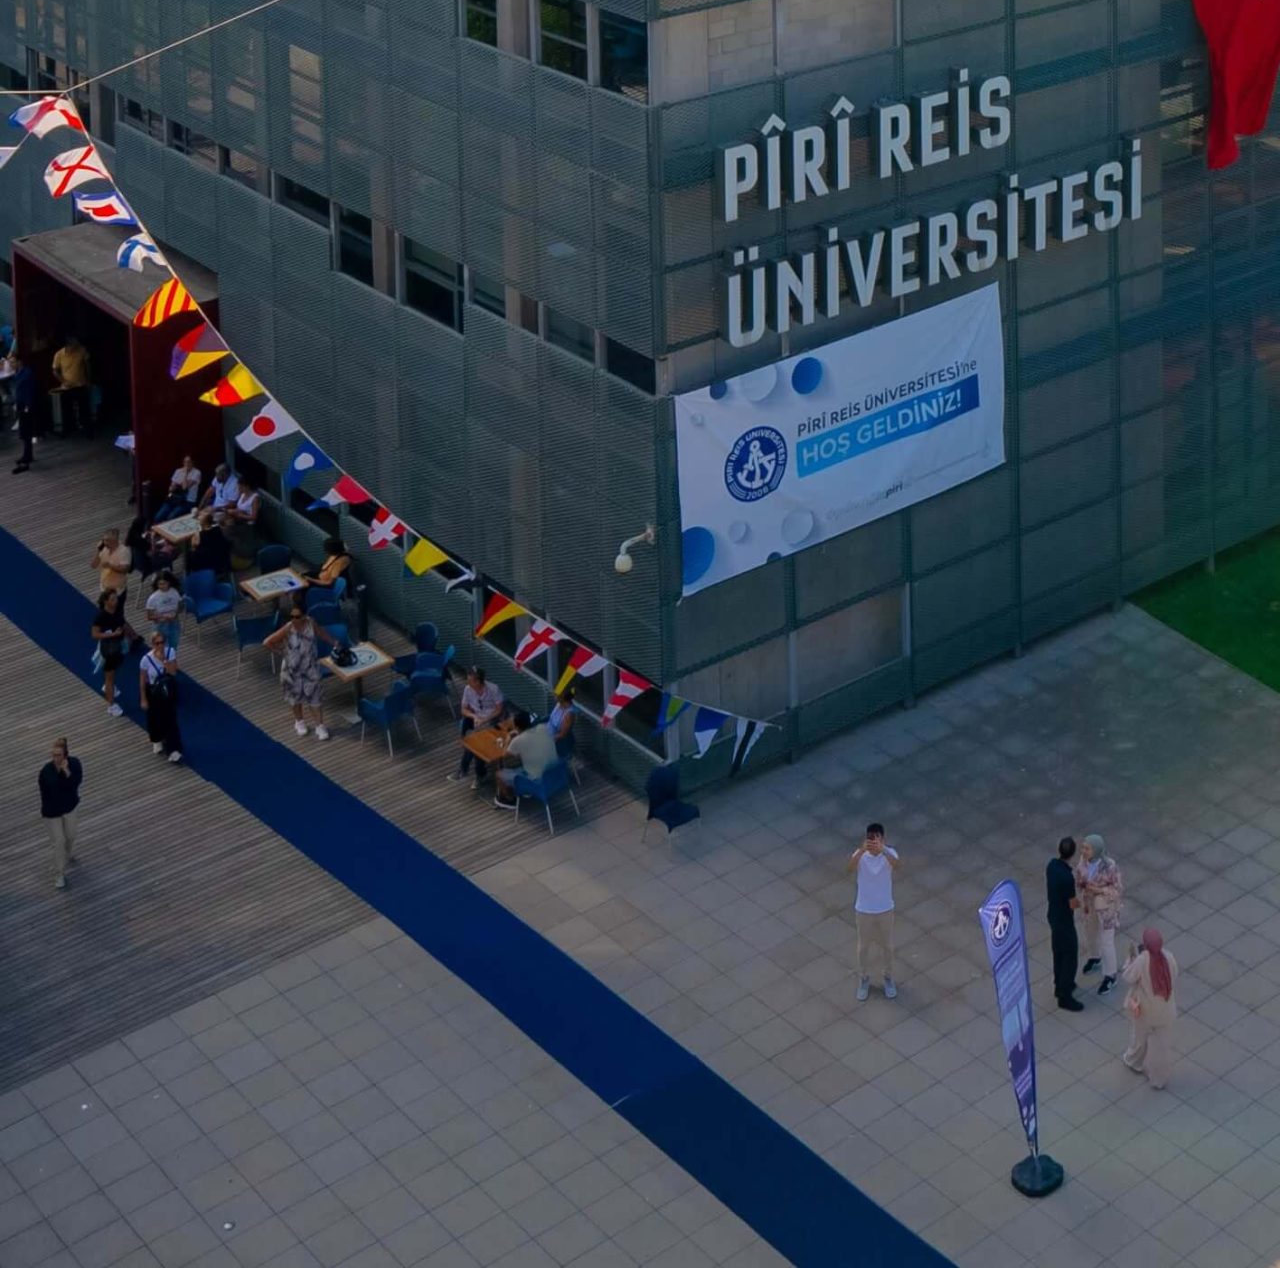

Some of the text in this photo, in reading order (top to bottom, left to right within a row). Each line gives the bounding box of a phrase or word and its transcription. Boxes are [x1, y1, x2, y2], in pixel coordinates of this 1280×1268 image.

[723, 67, 1011, 222] PÎRÎ REİS
[727, 138, 1143, 348] ÜNİVERSİTESİ
[802, 388, 962, 466] HOŞ GELDİNİZ!
[830, 401, 860, 426] REİS
